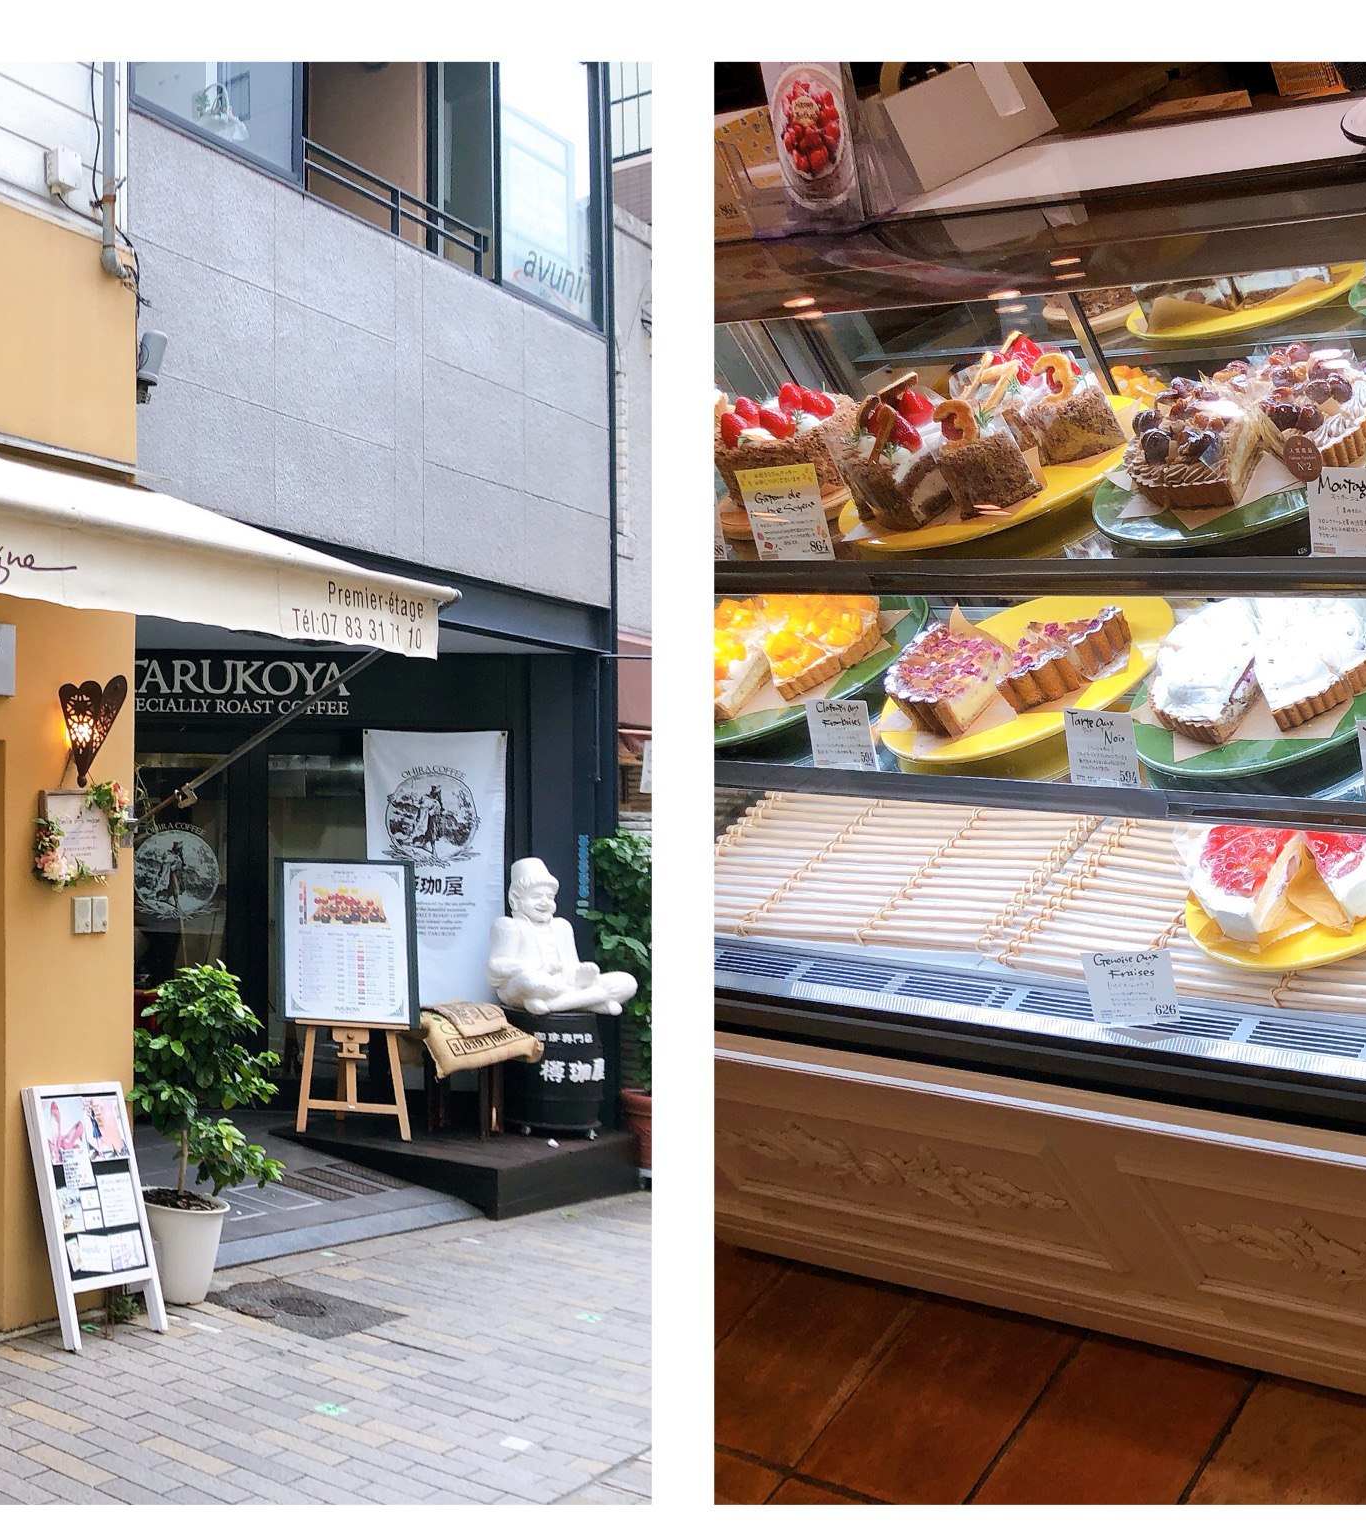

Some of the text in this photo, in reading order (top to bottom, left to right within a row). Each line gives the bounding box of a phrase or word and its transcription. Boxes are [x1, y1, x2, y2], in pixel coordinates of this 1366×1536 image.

[328, 581, 423, 622] Premier-étage
[345, 616, 362, 639] 83
[369, 619, 384, 642] 31
[409, 627, 422, 650] 10
[135, 698, 211, 713] ECIALLY
[216, 699, 273, 714] ROAST
[415, 876, 464, 896] 珈屋
[1155, 1004, 1176, 1015] 626
